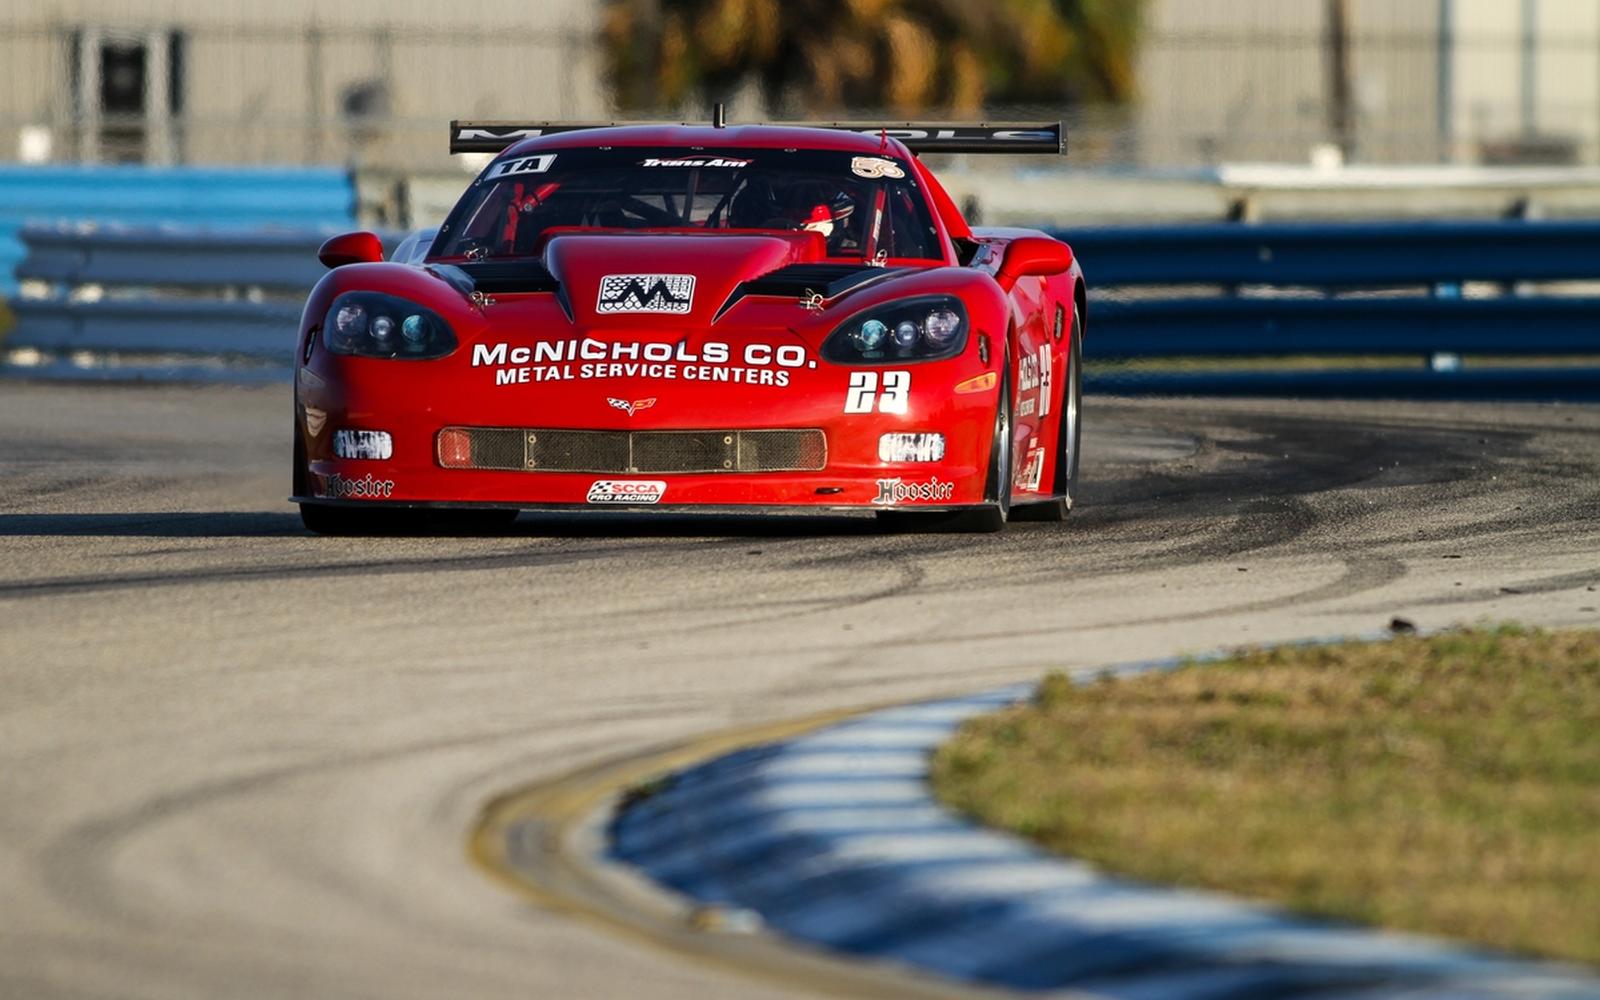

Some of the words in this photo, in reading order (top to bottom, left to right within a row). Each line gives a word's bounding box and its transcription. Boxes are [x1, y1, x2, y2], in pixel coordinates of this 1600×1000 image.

[499, 157, 542, 175] TA
[642, 158, 705, 168] Trans
[704, 158, 748, 168] Am
[472, 338, 729, 366] McNICHOLS
[744, 344, 817, 369] CO.
[496, 365, 575, 386] METAL
[580, 363, 677, 379] SERVICE
[683, 365, 790, 387] CENTERS
[843, 370, 911, 415] 23
[314, 472, 394, 499] Hoosier
[612, 484, 659, 493] SCCA
[871, 476, 955, 504] Hoosier
